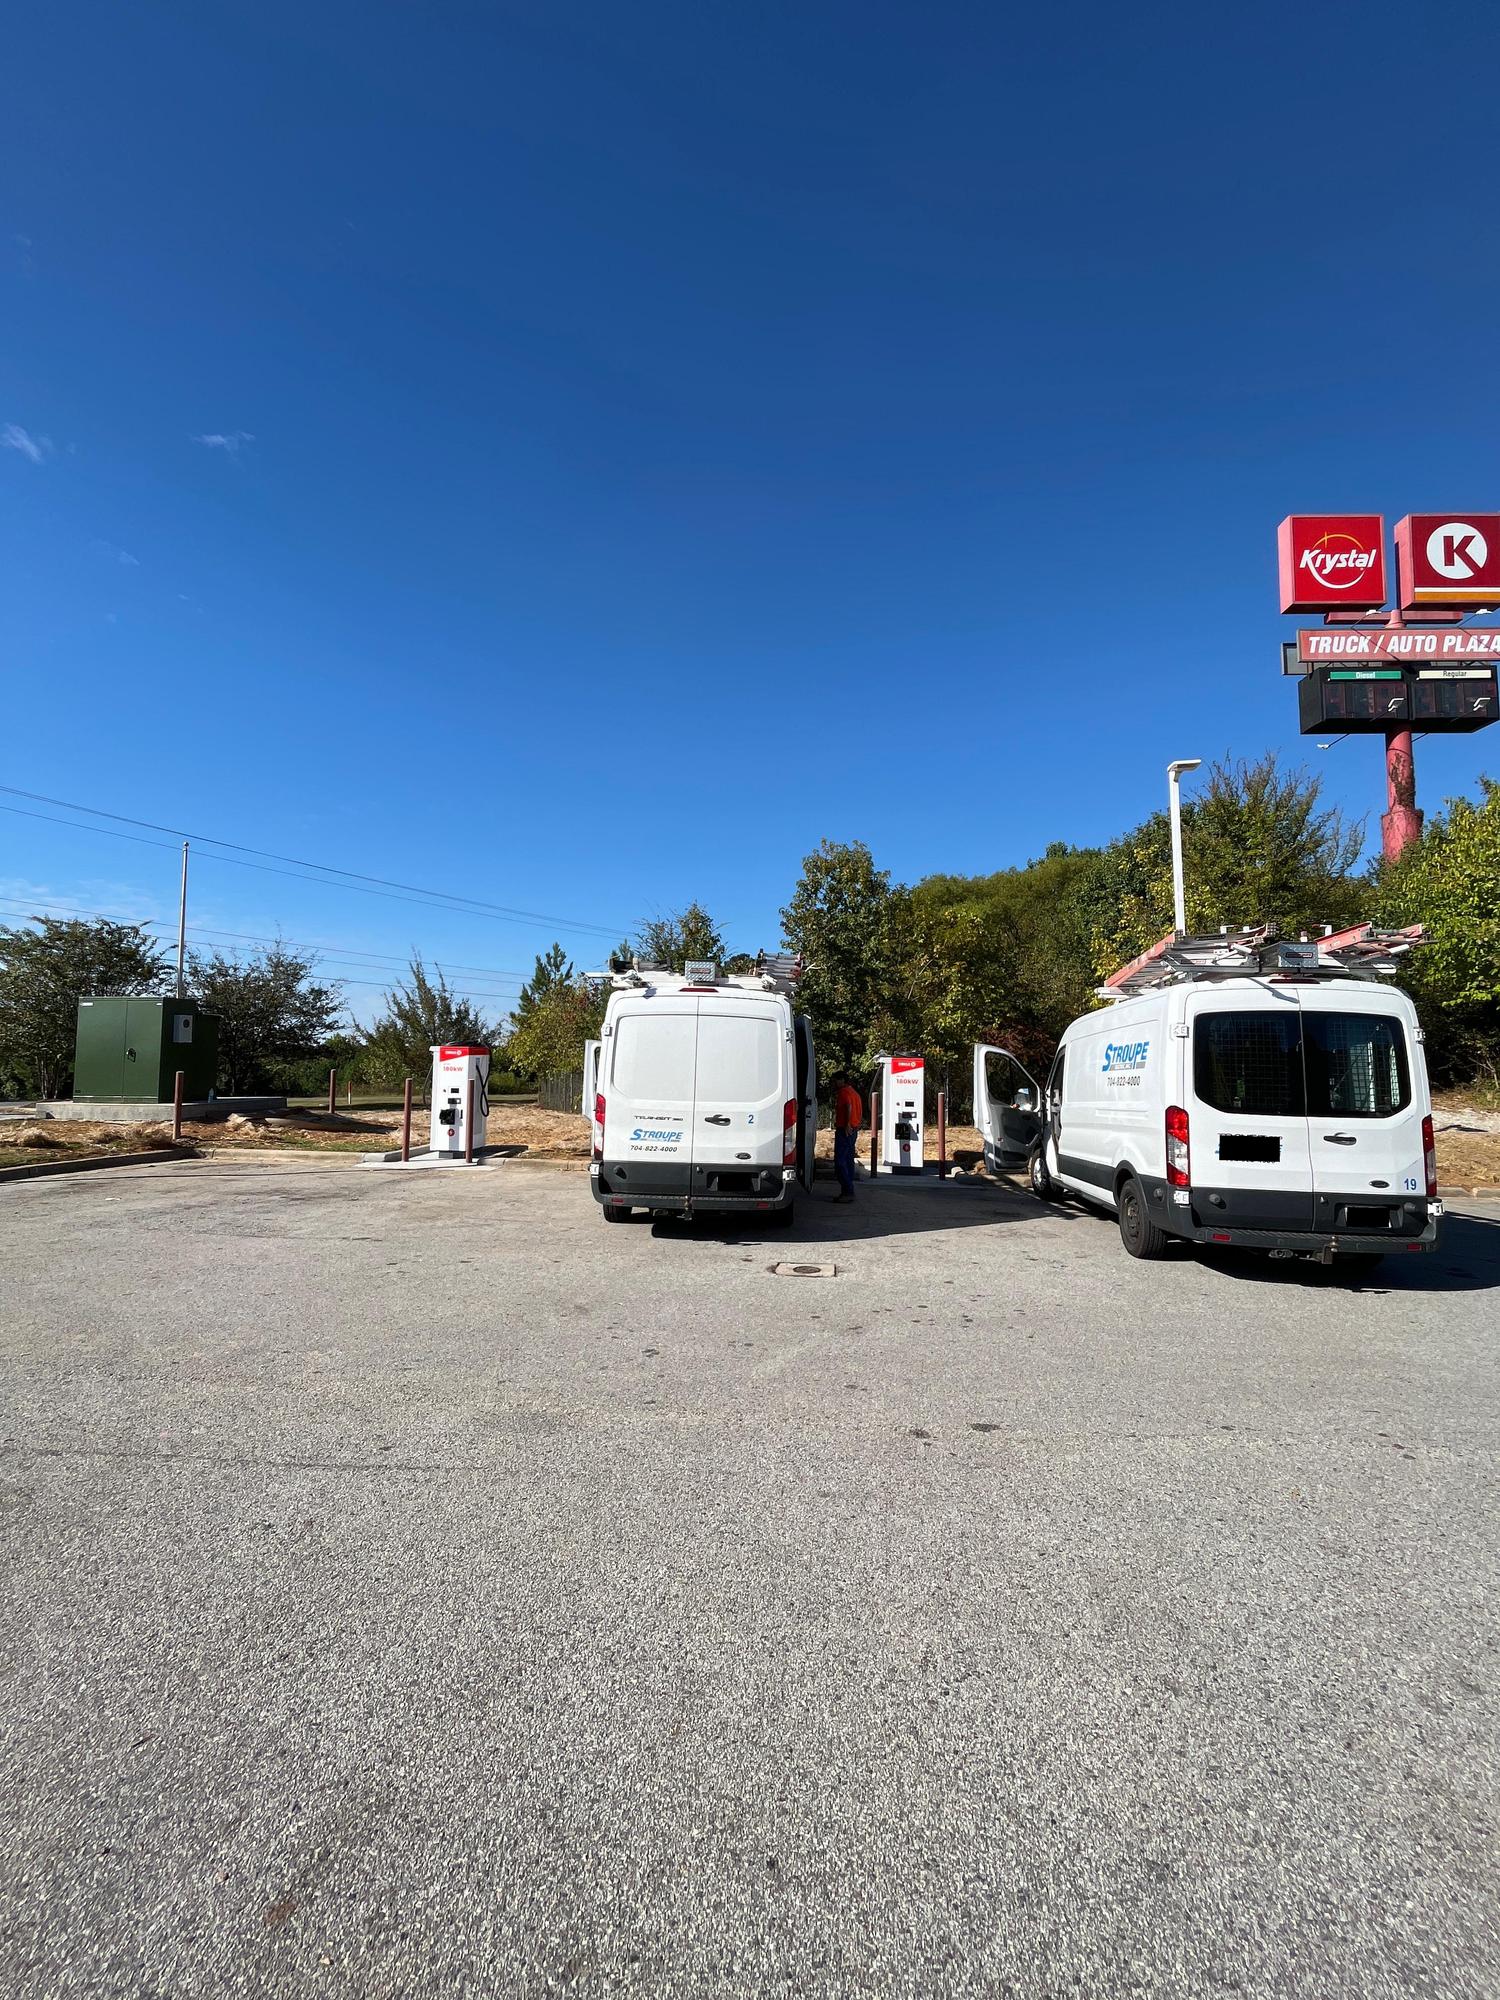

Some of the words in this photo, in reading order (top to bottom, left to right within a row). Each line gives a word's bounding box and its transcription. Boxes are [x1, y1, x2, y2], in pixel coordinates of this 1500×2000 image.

[1443, 535, 1483, 575] K
[1299, 549, 1377, 575] Krystal
[1308, 636, 1372, 654] TRUCK
[1373, 635, 1385, 654] /
[1386, 635, 1438, 653] AUTO
[1442, 634, 1500, 653] PLAZA
[1355, 671, 1376, 679] Diesel
[1442, 670, 1468, 679] Regular
[1102, 1041, 1150, 1072] STROUPE
[747, 1114, 755, 1124] 2
[630, 1128, 684, 1142] STROUPE
[630, 1144, 678, 1152] 704-822-4000
[1403, 1178, 1417, 1190] 19
